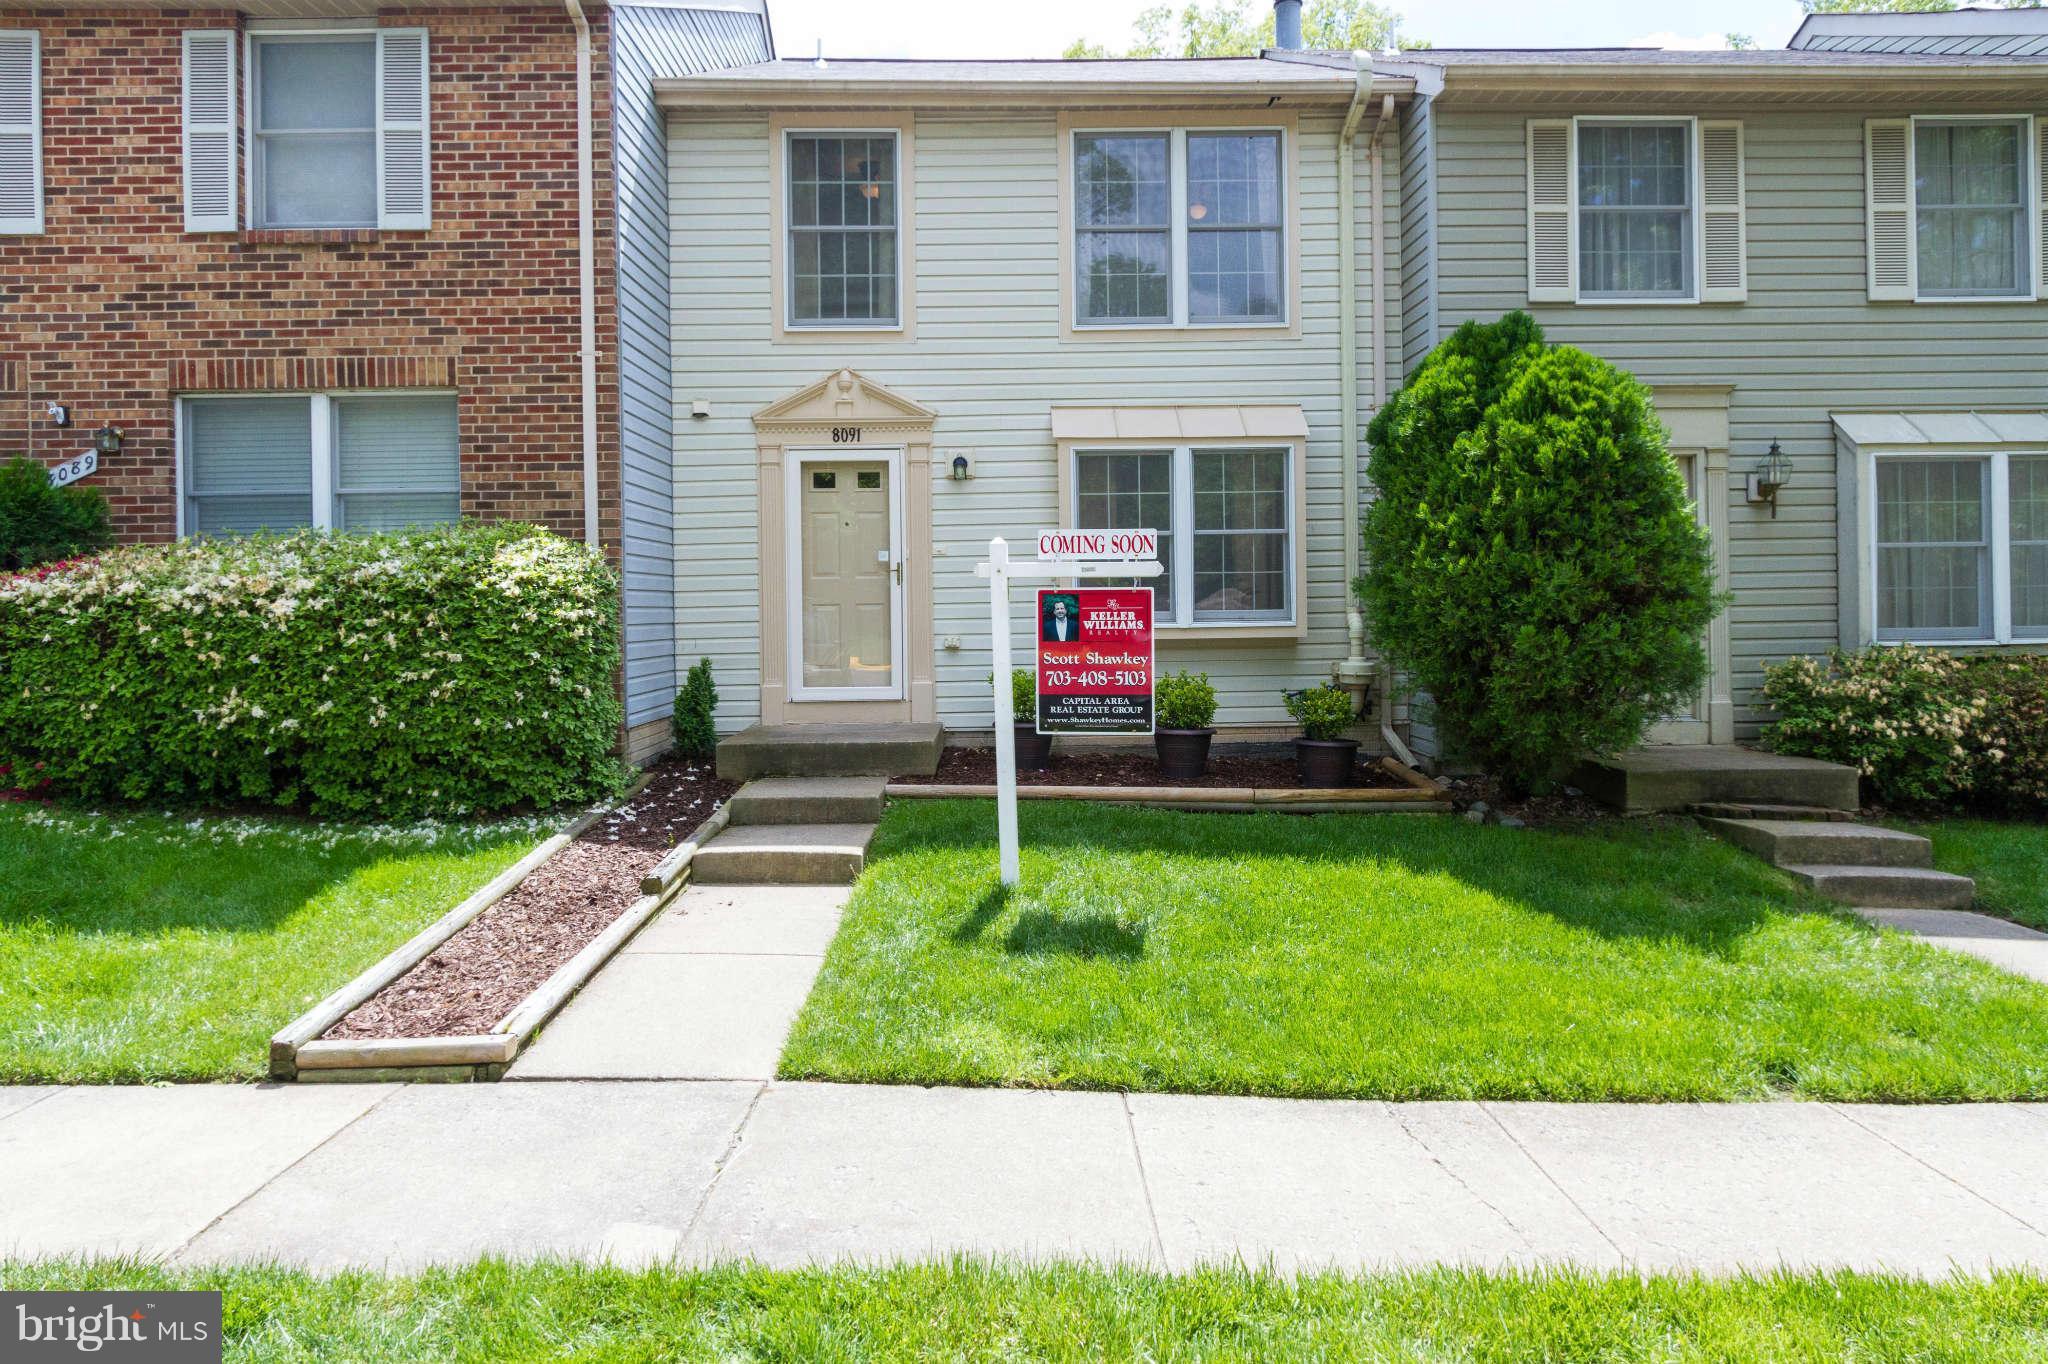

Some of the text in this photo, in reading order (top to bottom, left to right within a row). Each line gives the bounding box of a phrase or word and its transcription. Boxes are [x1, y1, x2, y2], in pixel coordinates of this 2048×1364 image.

[832, 427, 861, 443] 8091
[1040, 534, 1155, 554] COMING SOON
[1090, 611, 1136, 621] KELLER
[1083, 620, 1144, 630] WILLIAMS
[1043, 651, 1149, 667] Scott Shawkey
[1045, 670, 1147, 687] 703-408-5103
[1062, 697, 1130, 705] CAPITAL AREA
[1050, 706, 1144, 714] REAL ESTATE GROUP
[1047, 715, 1146, 724] www.ShawkeyHomes.com
